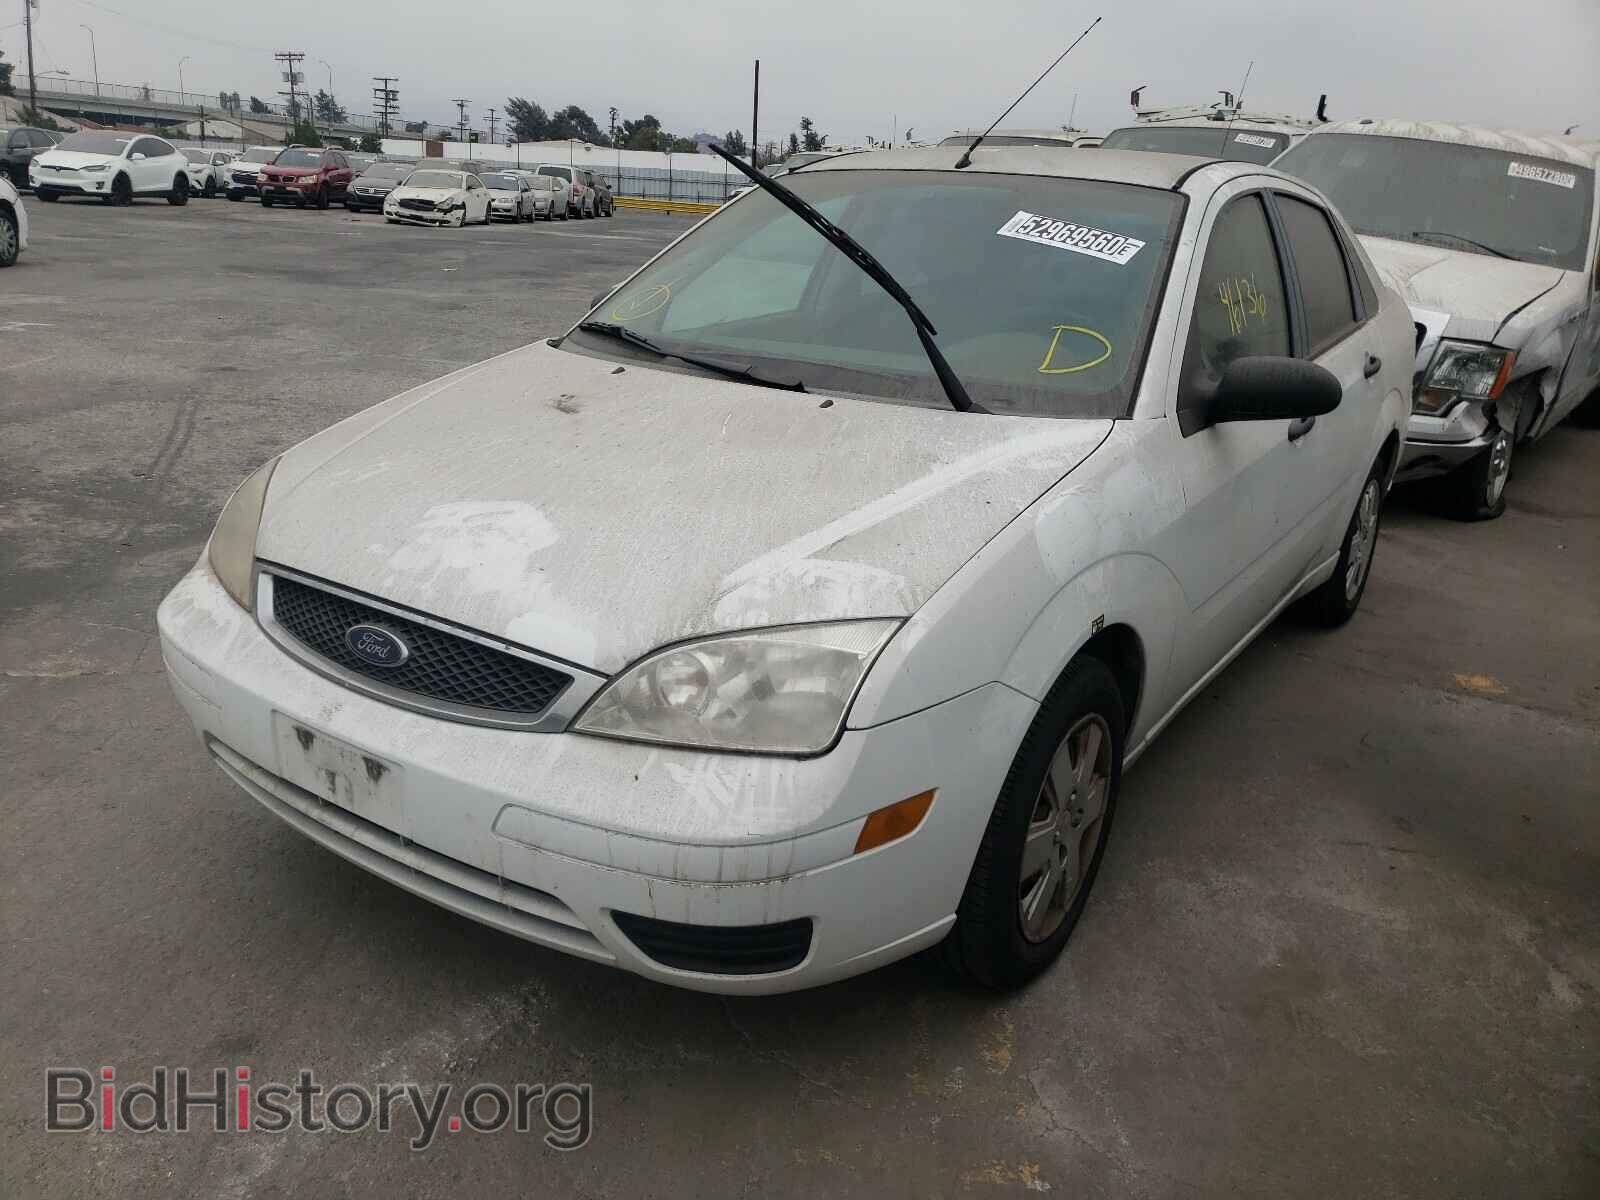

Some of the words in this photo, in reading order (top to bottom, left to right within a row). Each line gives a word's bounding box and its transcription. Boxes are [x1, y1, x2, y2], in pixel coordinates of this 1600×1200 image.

[1020, 216, 1125, 255] 52969560
[1038, 325, 1112, 373] D
[358, 632, 391, 658] Ford
